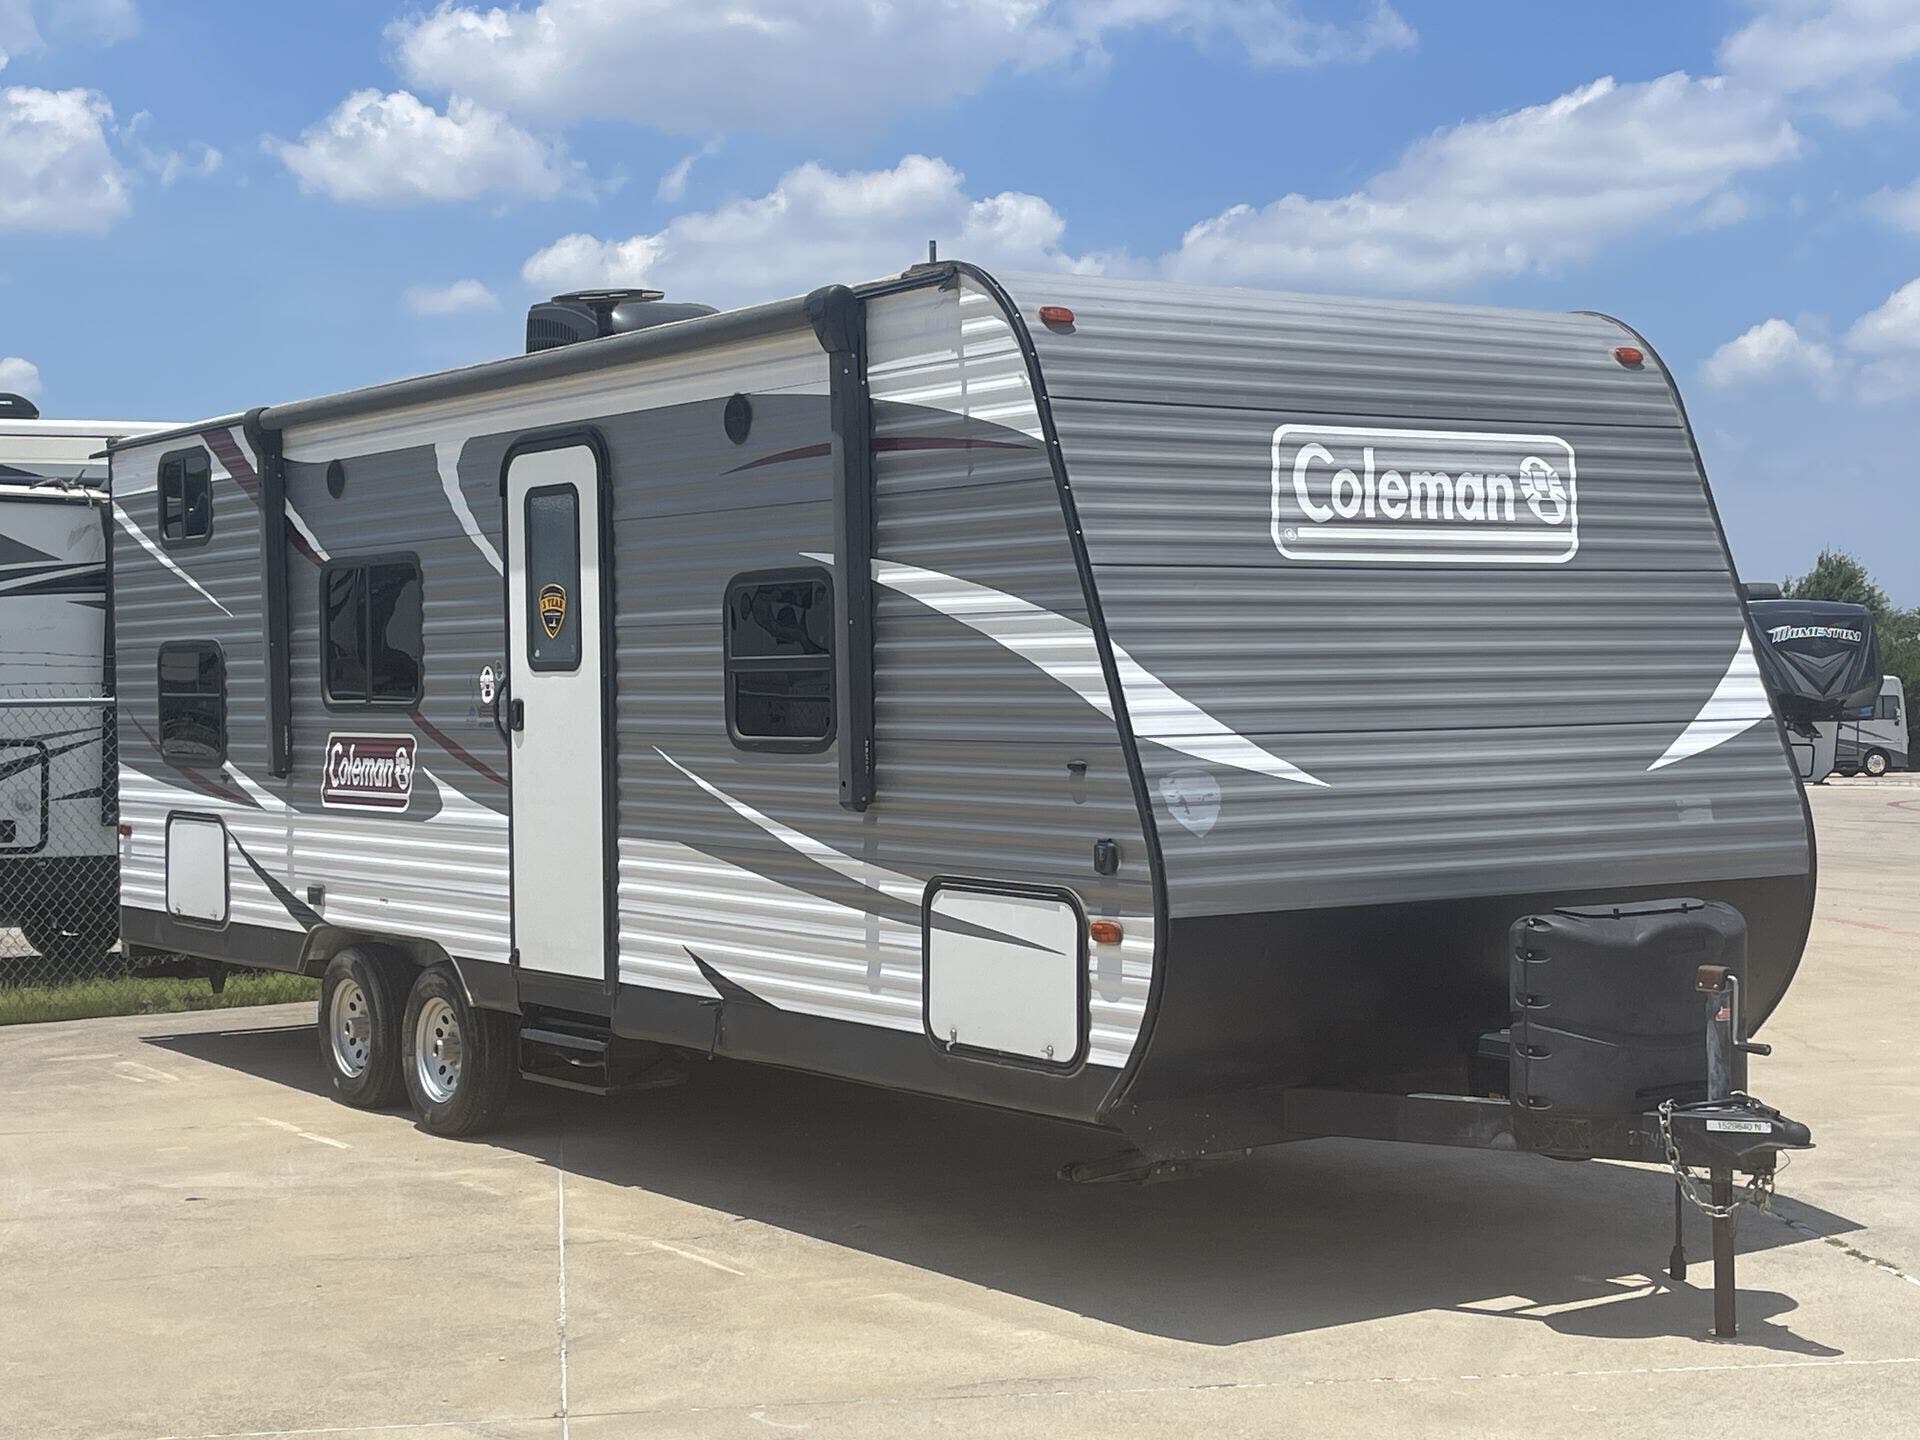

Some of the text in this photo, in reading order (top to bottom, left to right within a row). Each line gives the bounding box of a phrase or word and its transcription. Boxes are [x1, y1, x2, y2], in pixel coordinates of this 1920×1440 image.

[1292, 442, 1517, 523] Coleman
[1766, 625, 1862, 644] MOMENTUM
[328, 742, 395, 788] Coleman
